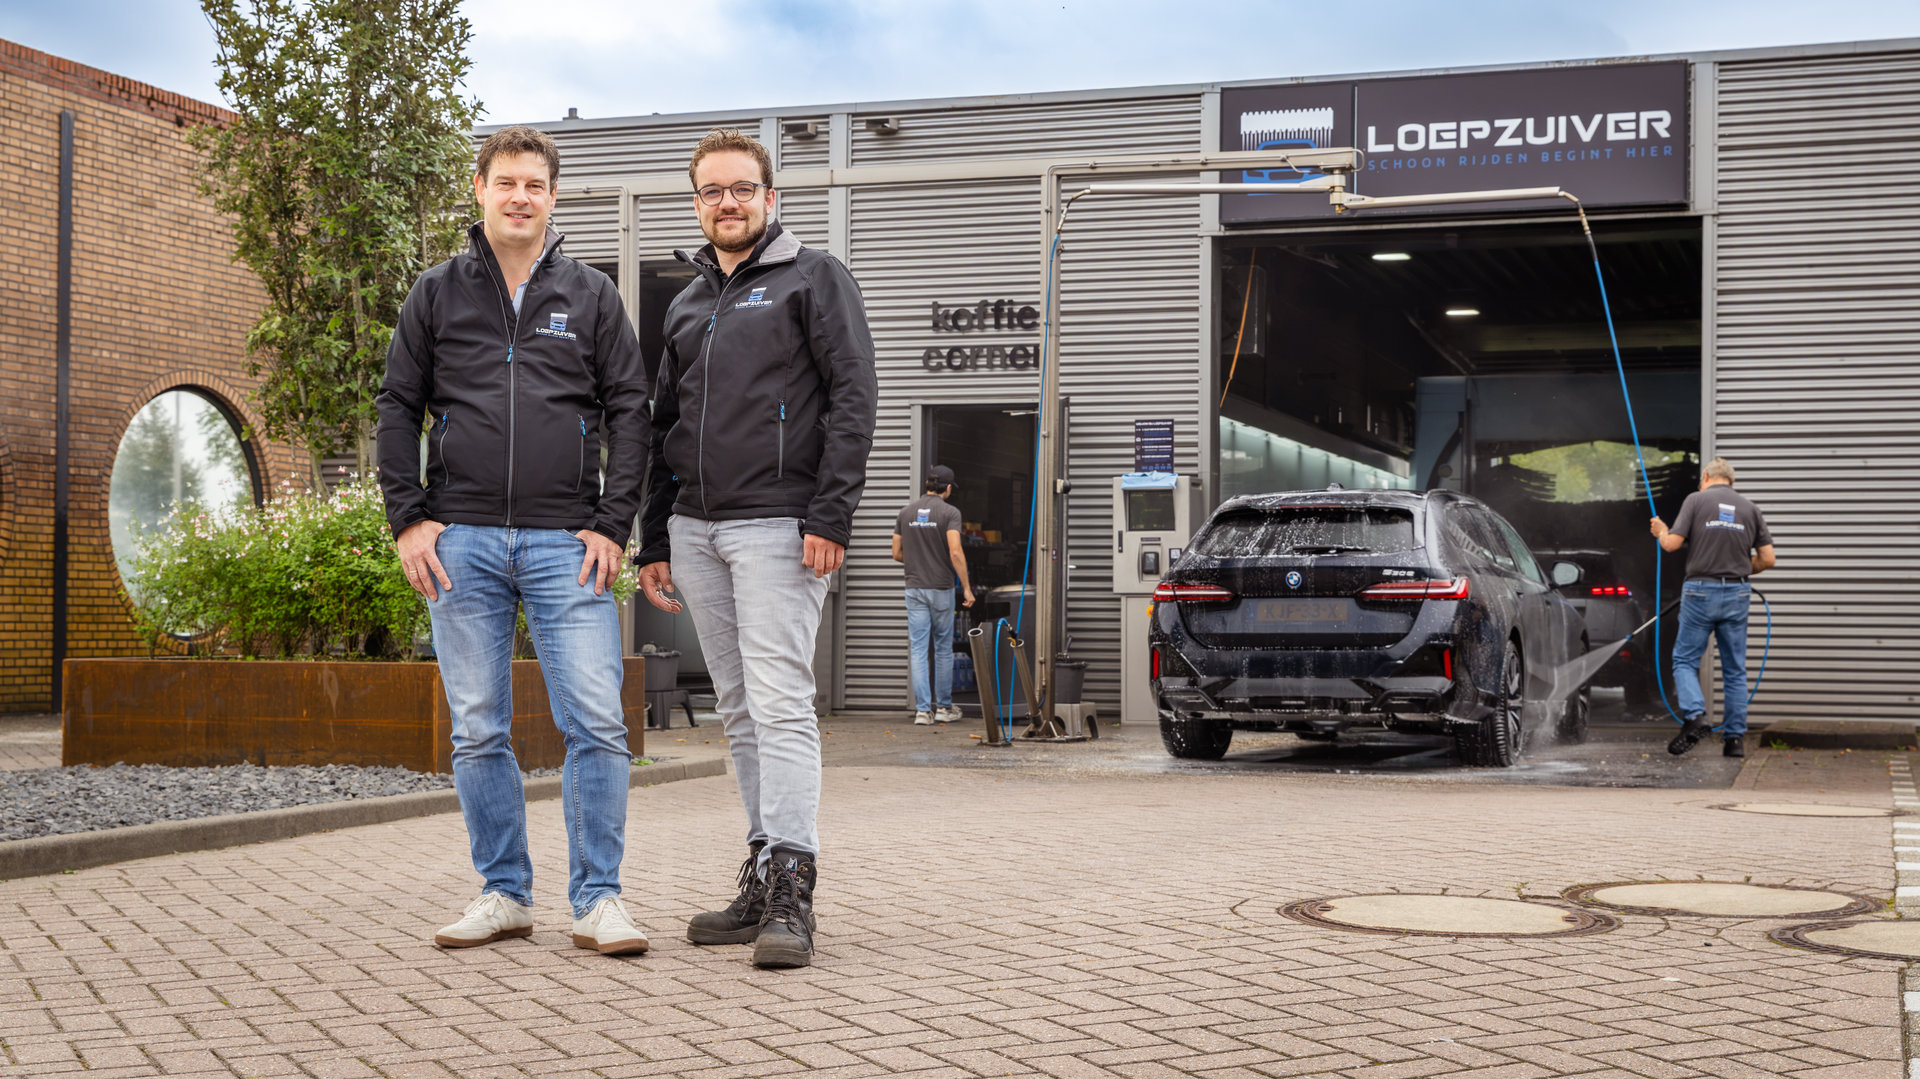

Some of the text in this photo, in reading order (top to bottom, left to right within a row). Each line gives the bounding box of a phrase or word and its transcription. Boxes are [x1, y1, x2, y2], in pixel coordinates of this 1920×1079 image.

[1367, 110, 1672, 153] LOEPZUIVER
[1367, 145, 1673, 171] SCHOON RIJDEN BEGINT HIER
[931, 298, 1039, 332] koffie
